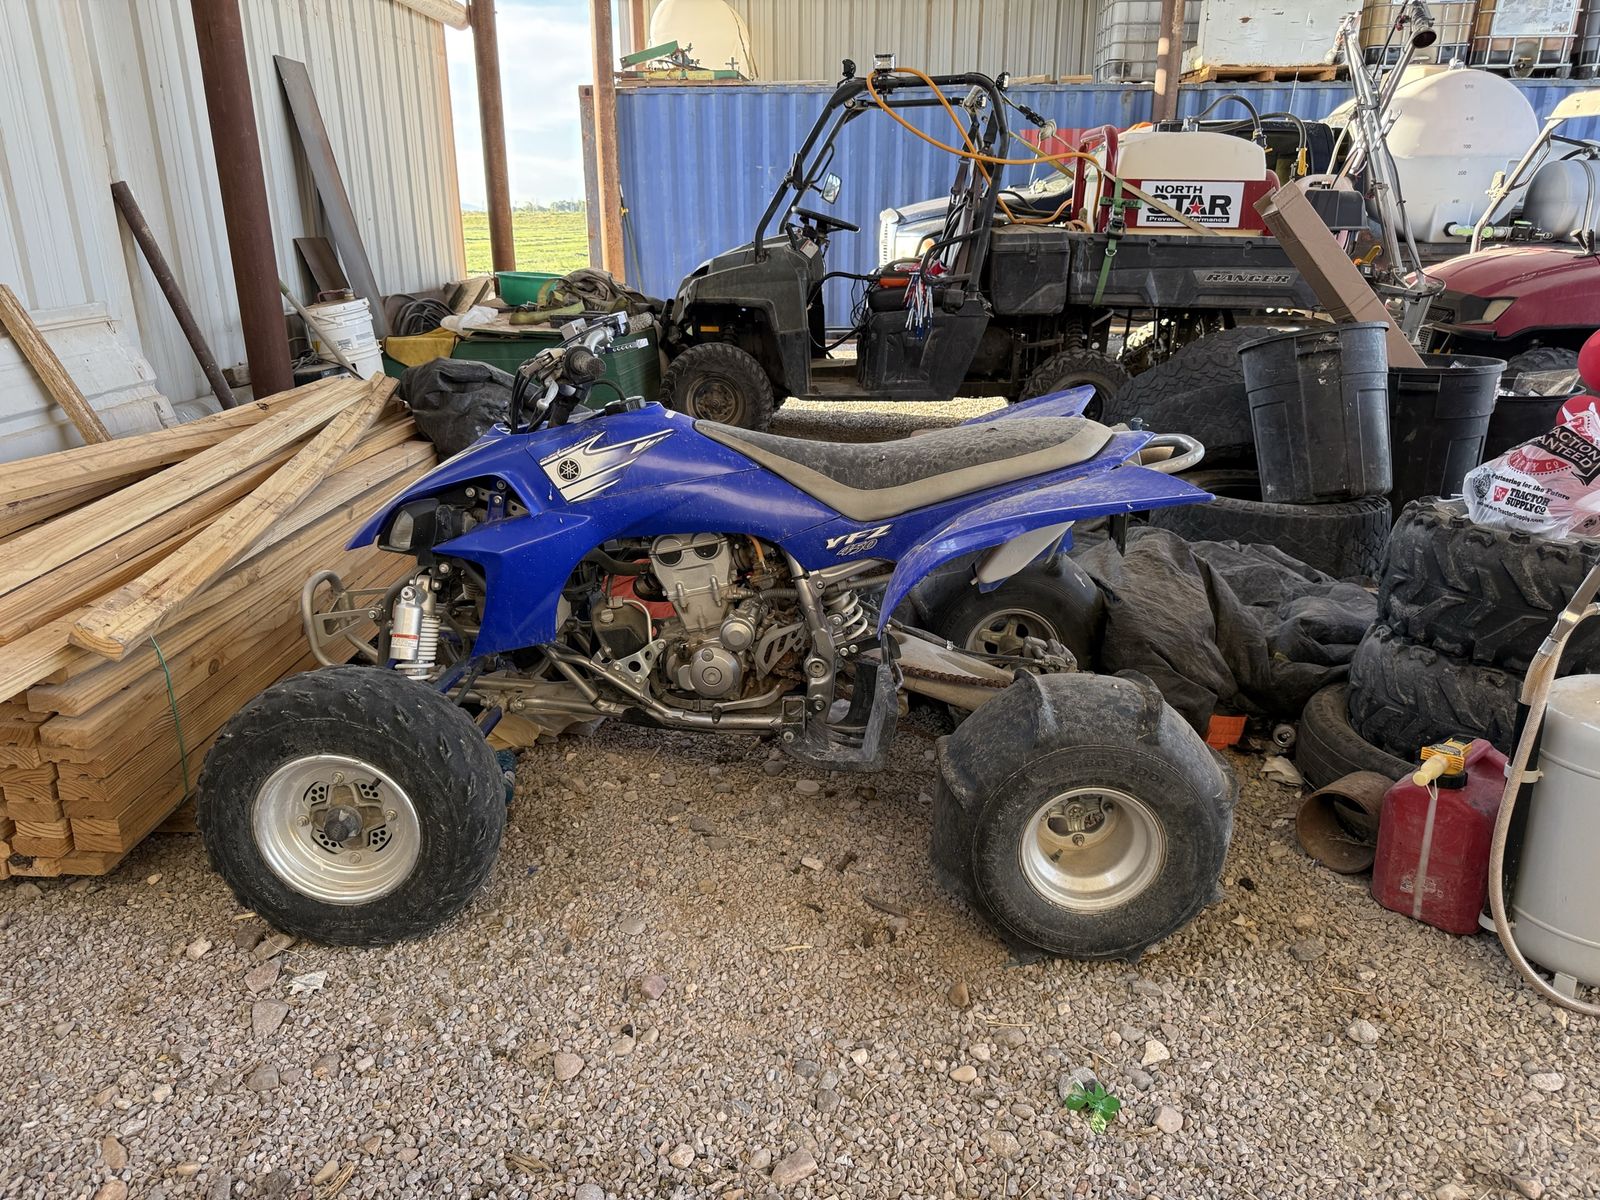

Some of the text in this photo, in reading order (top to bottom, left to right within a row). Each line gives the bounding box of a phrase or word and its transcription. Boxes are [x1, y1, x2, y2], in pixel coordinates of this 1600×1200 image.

[1154, 185, 1203, 194] NORTH
[1146, 193, 1232, 216] STAR
[1204, 274, 1291, 284] RANGER
[1491, 473, 1522, 487] Partnering
[1522, 482, 1531, 490] for
[1533, 484, 1545, 493] the
[1545, 487, 1571, 501] Future
[1505, 496, 1534, 513] SUPPLY
[1509, 487, 1551, 507] TRACTOR
[826, 523, 894, 549] YFZ
[836, 538, 878, 556] 450
